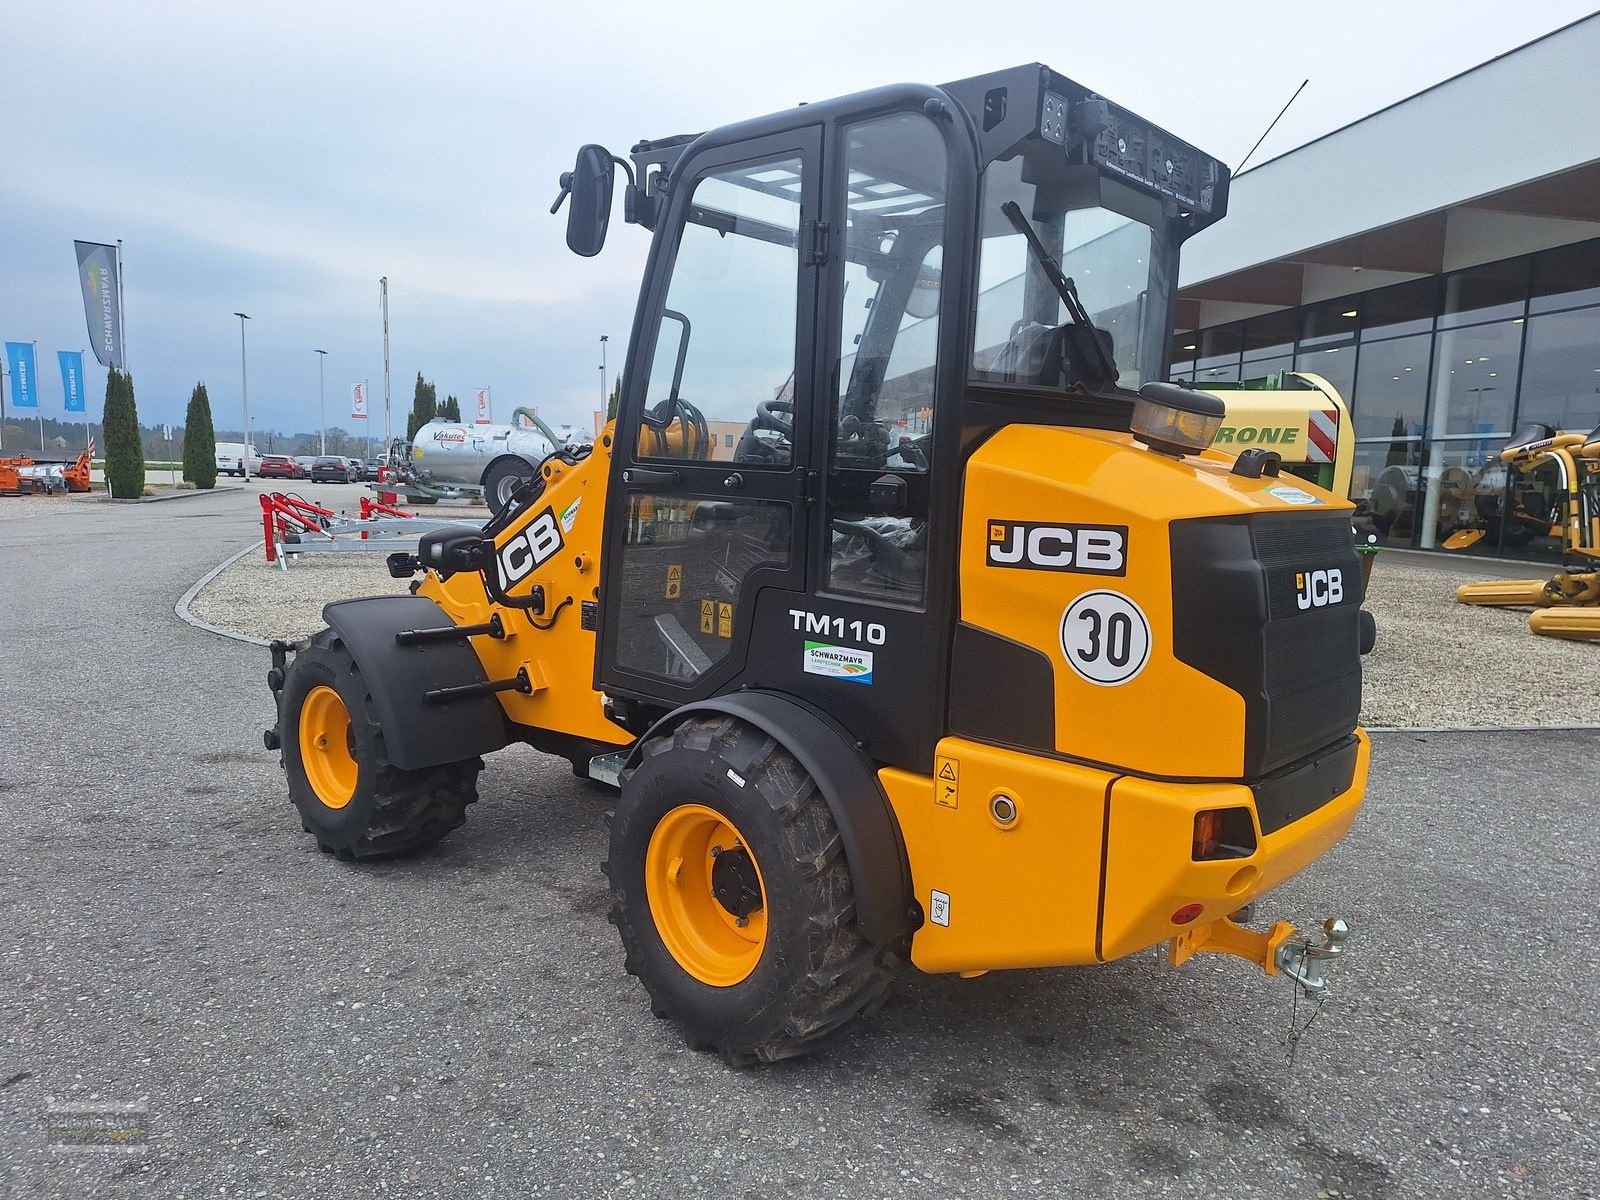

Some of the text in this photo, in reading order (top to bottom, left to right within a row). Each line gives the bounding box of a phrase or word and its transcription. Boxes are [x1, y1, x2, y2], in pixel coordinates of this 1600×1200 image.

[433, 430, 466, 441] Vakutec
[1214, 426, 1300, 445] RONE
[989, 526, 1123, 570] JCB
[1297, 568, 1343, 610] JCB
[789, 609, 886, 646] TM110
[1077, 607, 1133, 668] 30
[810, 649, 863, 665] SCHWARZMAYR
